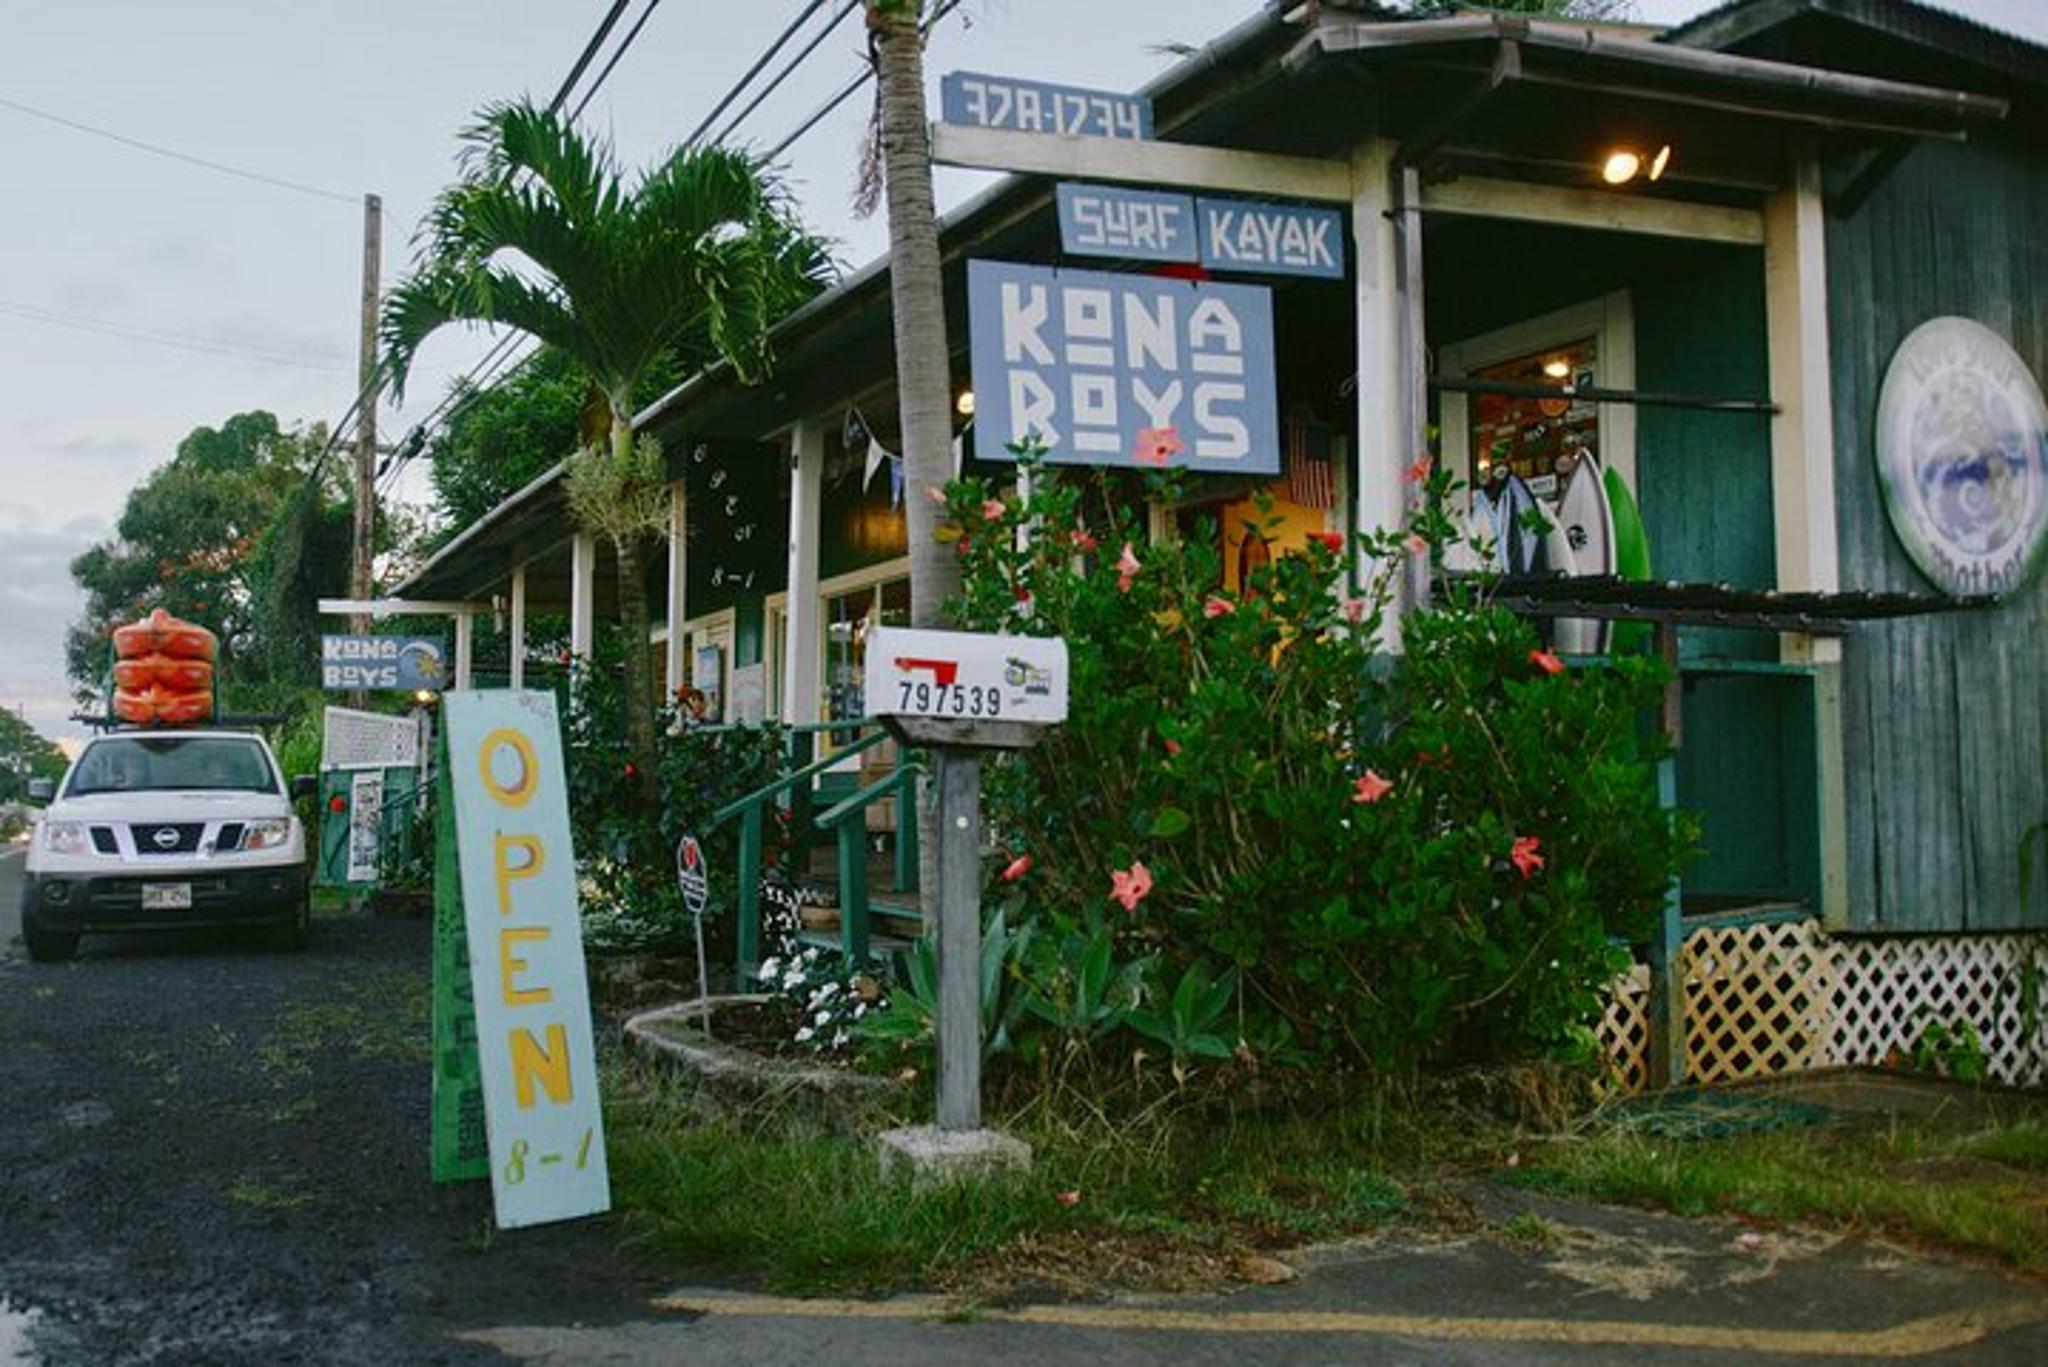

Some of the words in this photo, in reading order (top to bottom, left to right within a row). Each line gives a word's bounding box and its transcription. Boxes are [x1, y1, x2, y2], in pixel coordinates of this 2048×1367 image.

[1072, 195, 1180, 250] SURF
[1208, 209, 1335, 268] KAYAK
[1001, 281, 1244, 375] KONA
[1007, 369, 1250, 459] BOYS
[322, 636, 398, 661] KONA
[323, 665, 398, 688] BOYS
[899, 681, 1001, 716] 797539
[477, 727, 574, 1110] OPEN
